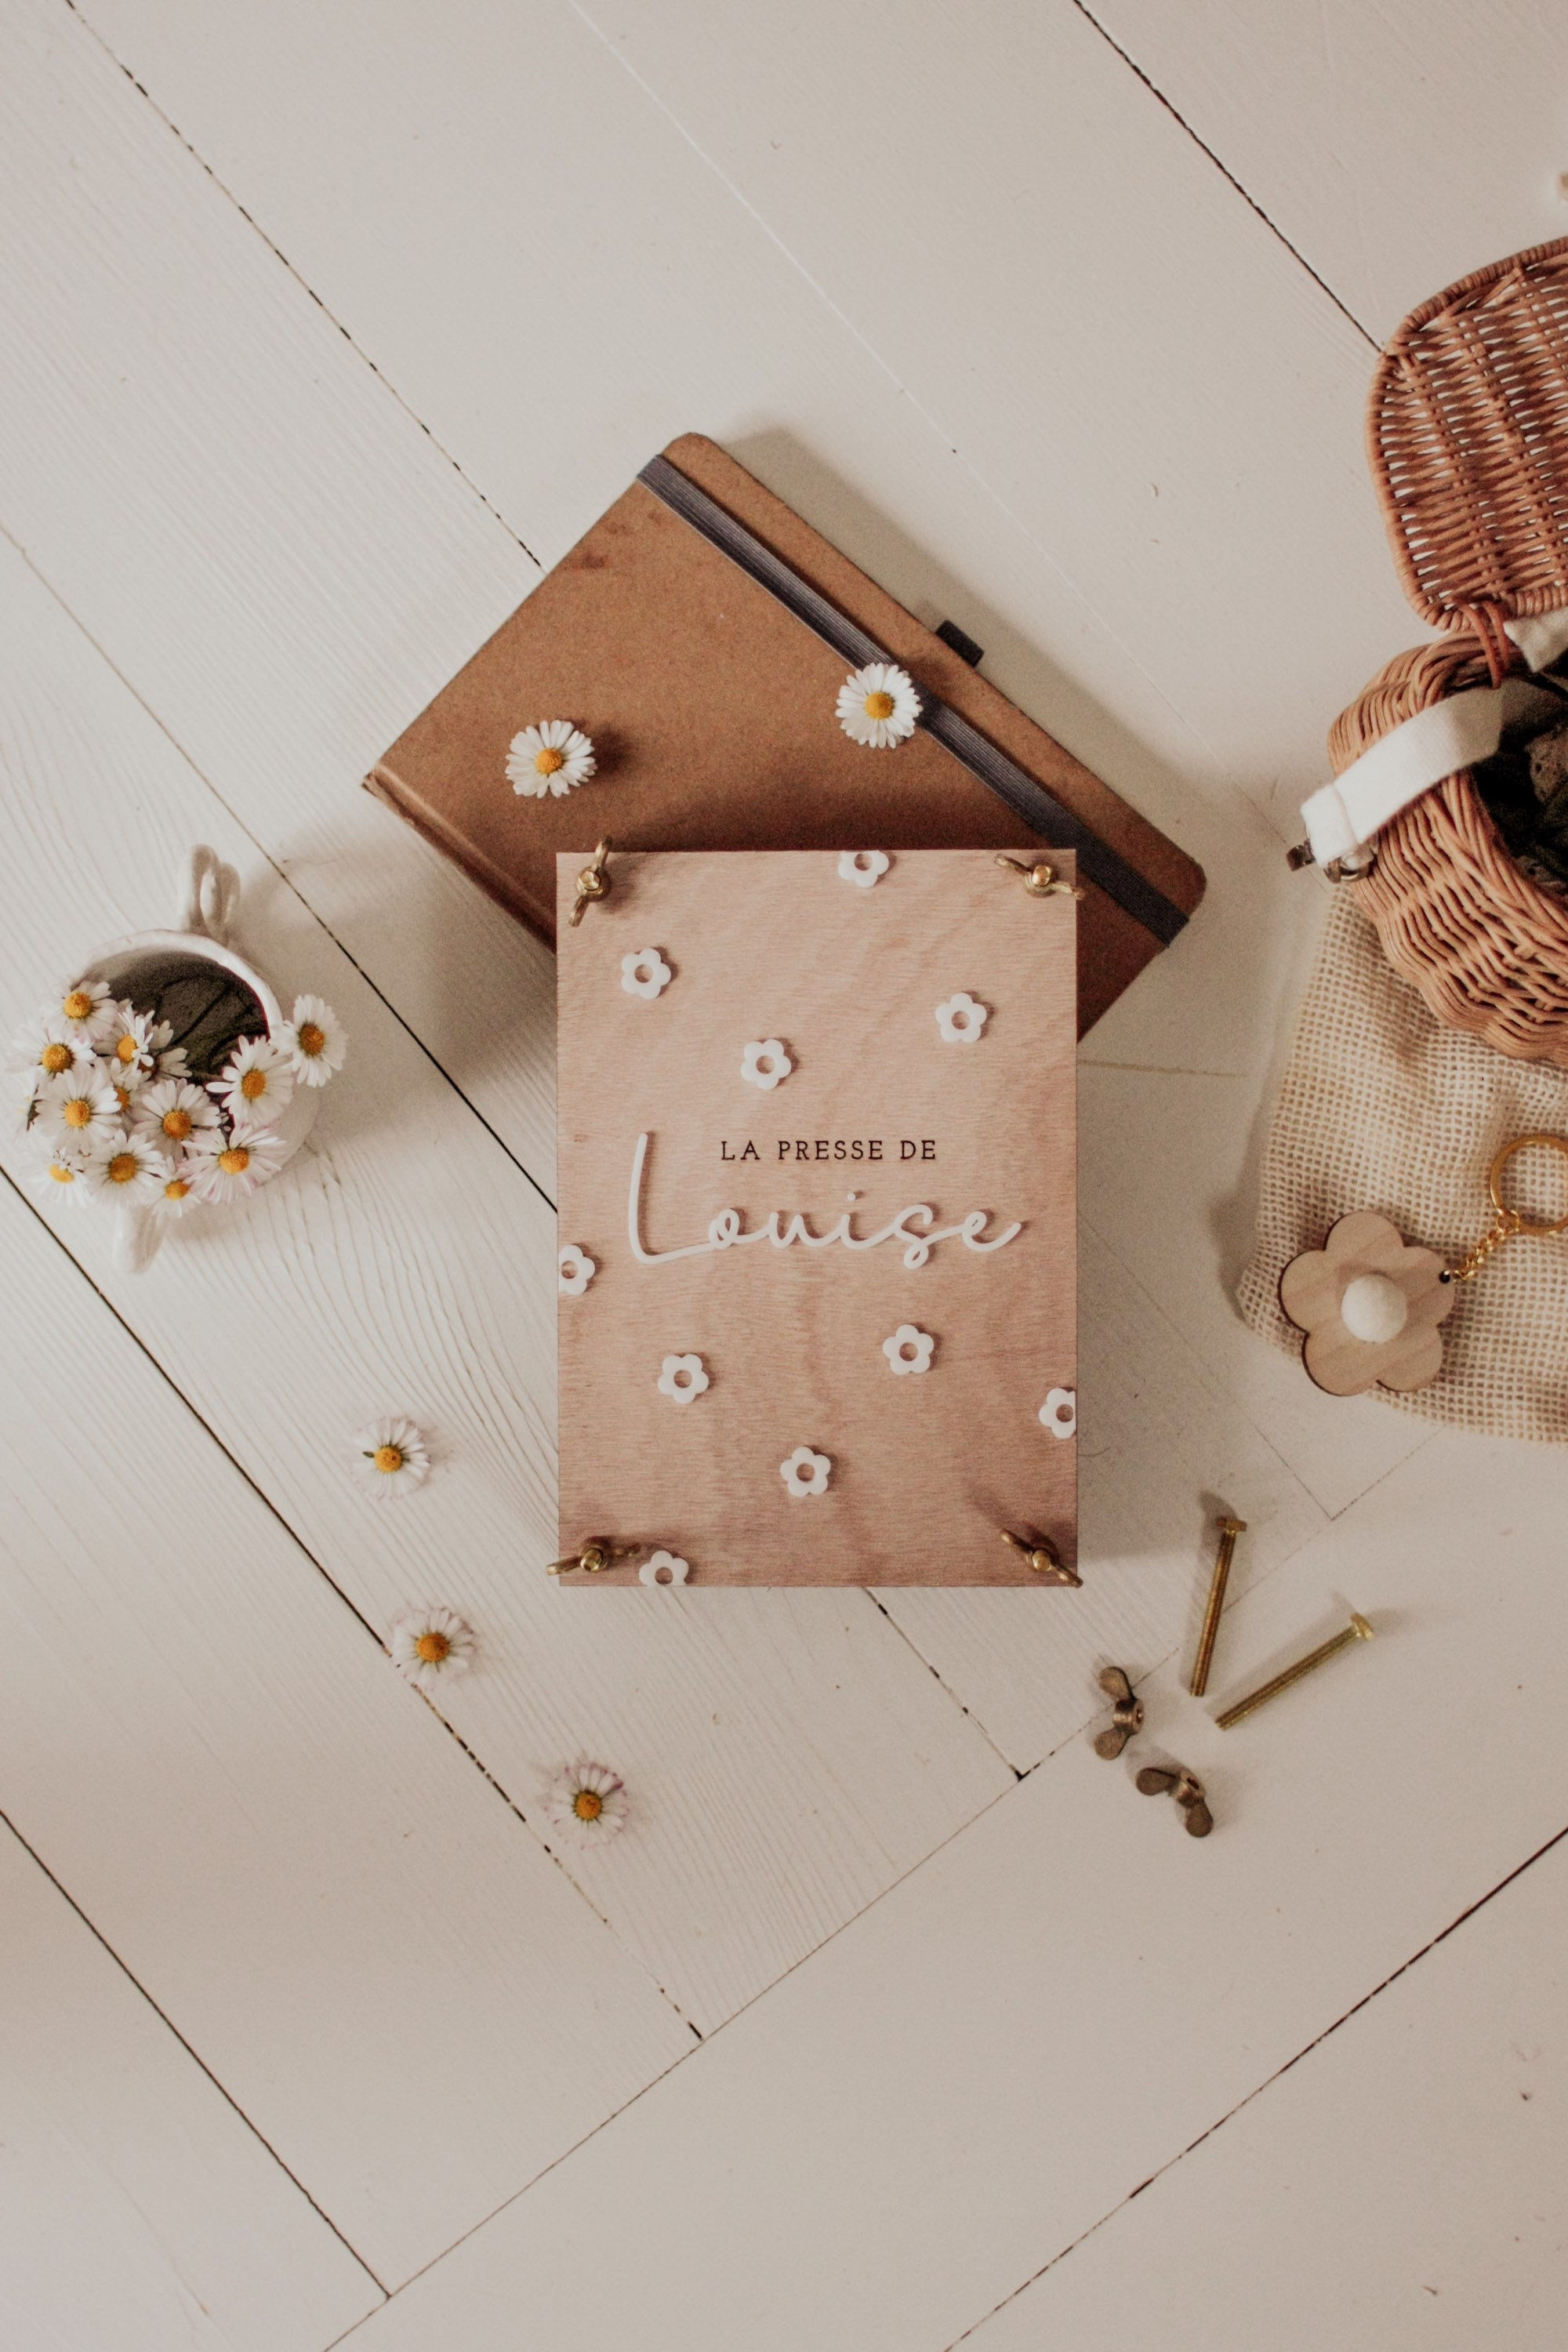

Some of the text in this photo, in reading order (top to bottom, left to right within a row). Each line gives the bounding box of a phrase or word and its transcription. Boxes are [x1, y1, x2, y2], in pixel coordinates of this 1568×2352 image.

[721, 1140, 936, 1160] LA PRESSE DE
[629, 1132, 1022, 1270] Louise
